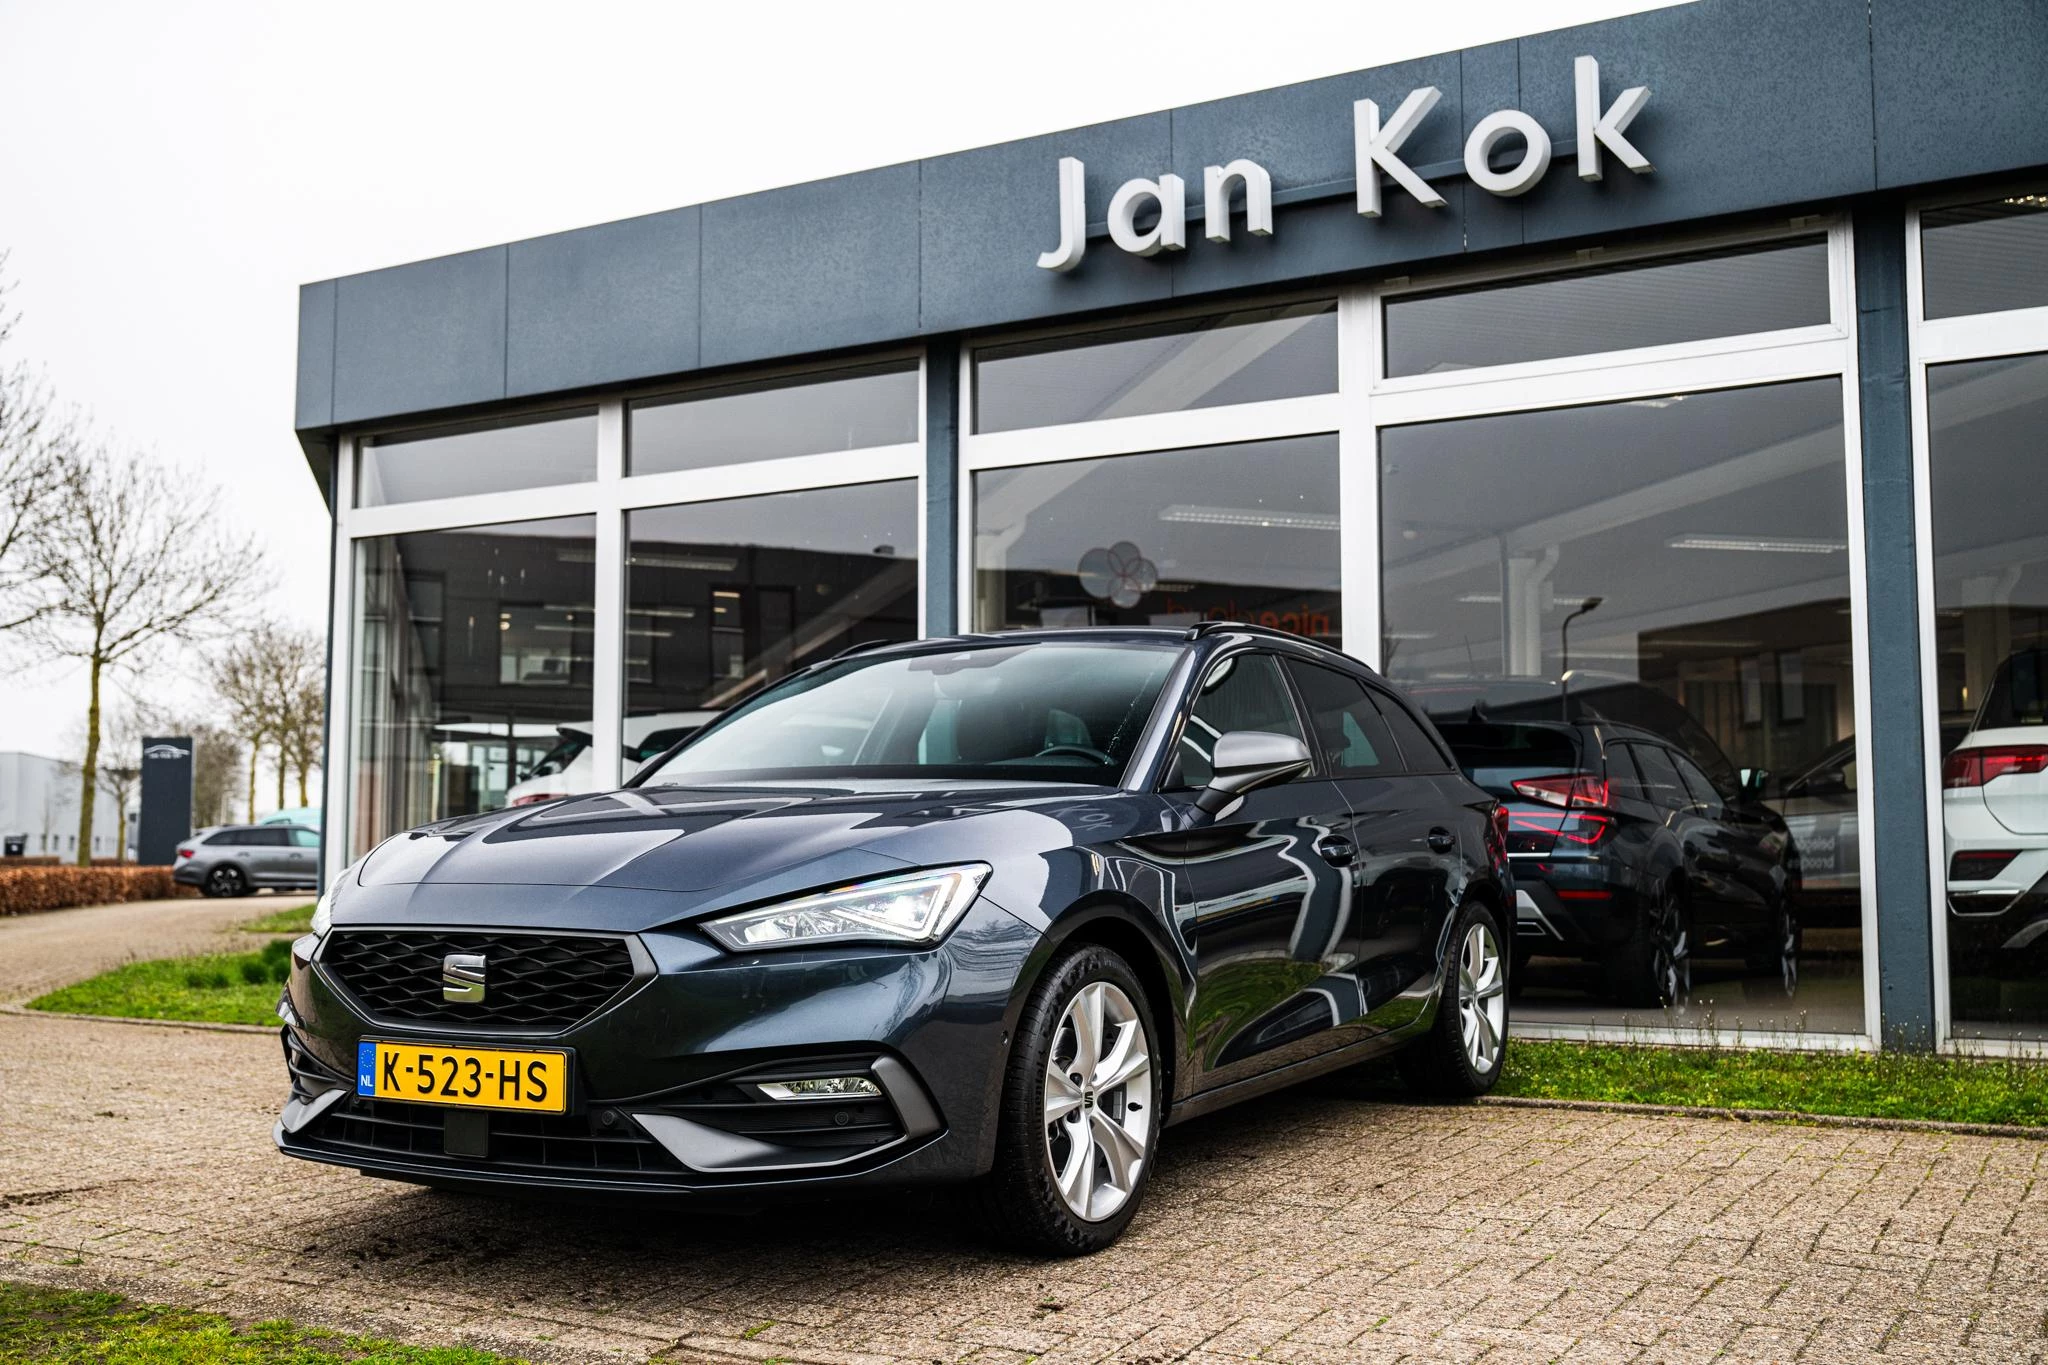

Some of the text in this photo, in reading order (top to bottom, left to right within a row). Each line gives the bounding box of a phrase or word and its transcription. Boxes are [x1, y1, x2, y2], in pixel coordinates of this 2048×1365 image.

[1036, 55, 1657, 273] Jan Kok
[360, 1075, 373, 1087] NL
[383, 1051, 547, 1102] K-523-HS
